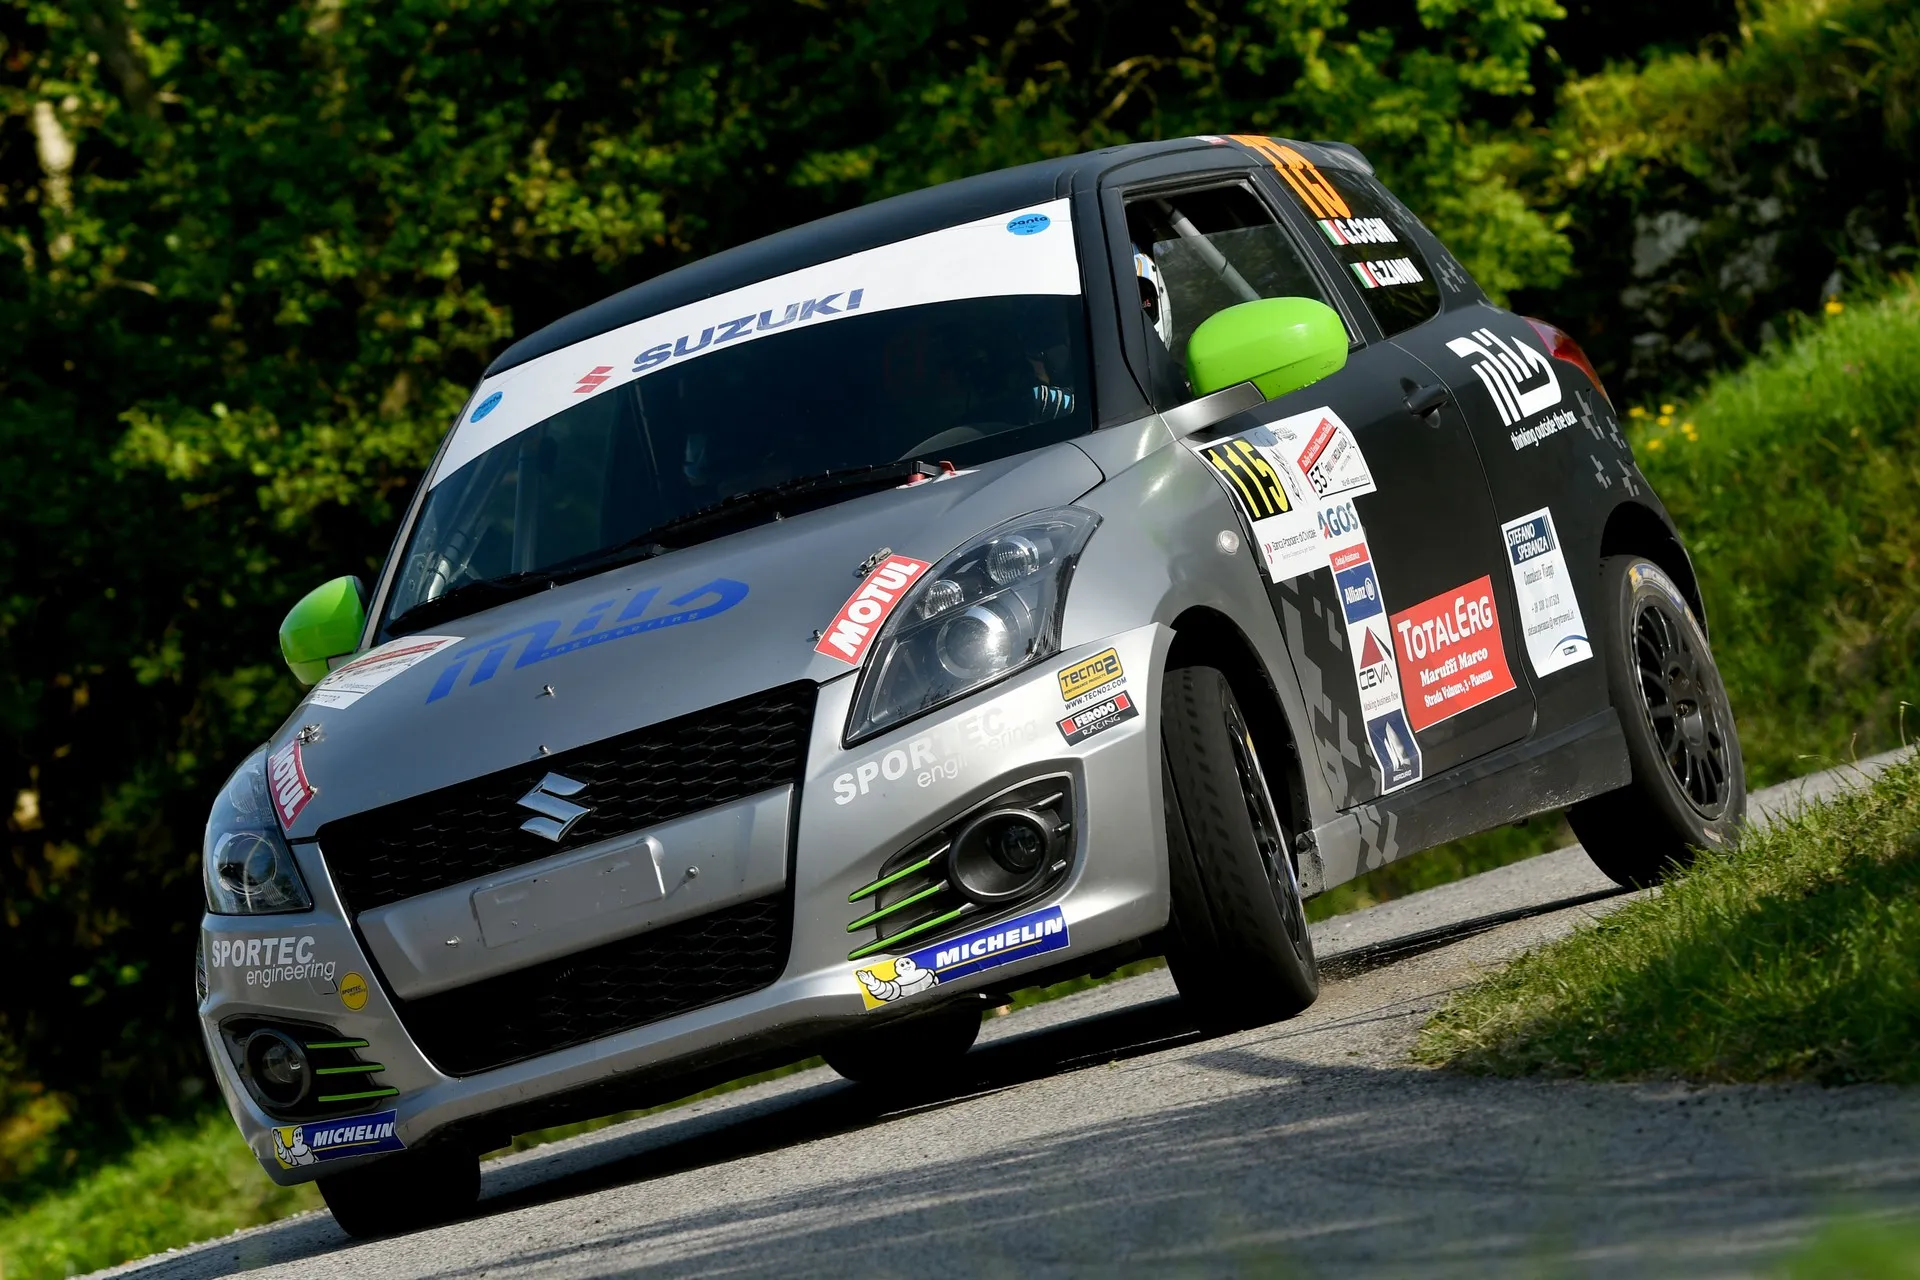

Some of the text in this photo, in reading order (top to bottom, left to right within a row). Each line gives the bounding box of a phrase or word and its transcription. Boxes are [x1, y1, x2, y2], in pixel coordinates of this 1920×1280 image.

[632, 288, 864, 373] SUZUKI
[1510, 408, 1578, 451] thinking outside the box
[1207, 440, 1289, 519] 115
[1316, 502, 1358, 540] AGOS
[1508, 523, 1535, 547] STEFANO
[1517, 535, 1549, 562] SPERANZA
[828, 561, 921, 658] MOTUL
[1344, 586, 1367, 605] Allianz
[1420, 648, 1488, 687] Maruffi Marco
[1064, 677, 1127, 711] WWW.TECNO2.COM
[1377, 695, 1391, 707] business
[1390, 690, 1399, 702] flow
[1074, 701, 1116, 728] FERODO
[1082, 713, 1121, 736] RACING
[273, 740, 306, 820] MOTUL
[212, 935, 315, 968] SPORTEC
[935, 916, 1063, 969] MICHELIN
[246, 959, 336, 988] engineering
[313, 1122, 394, 1147] MICHELIN
